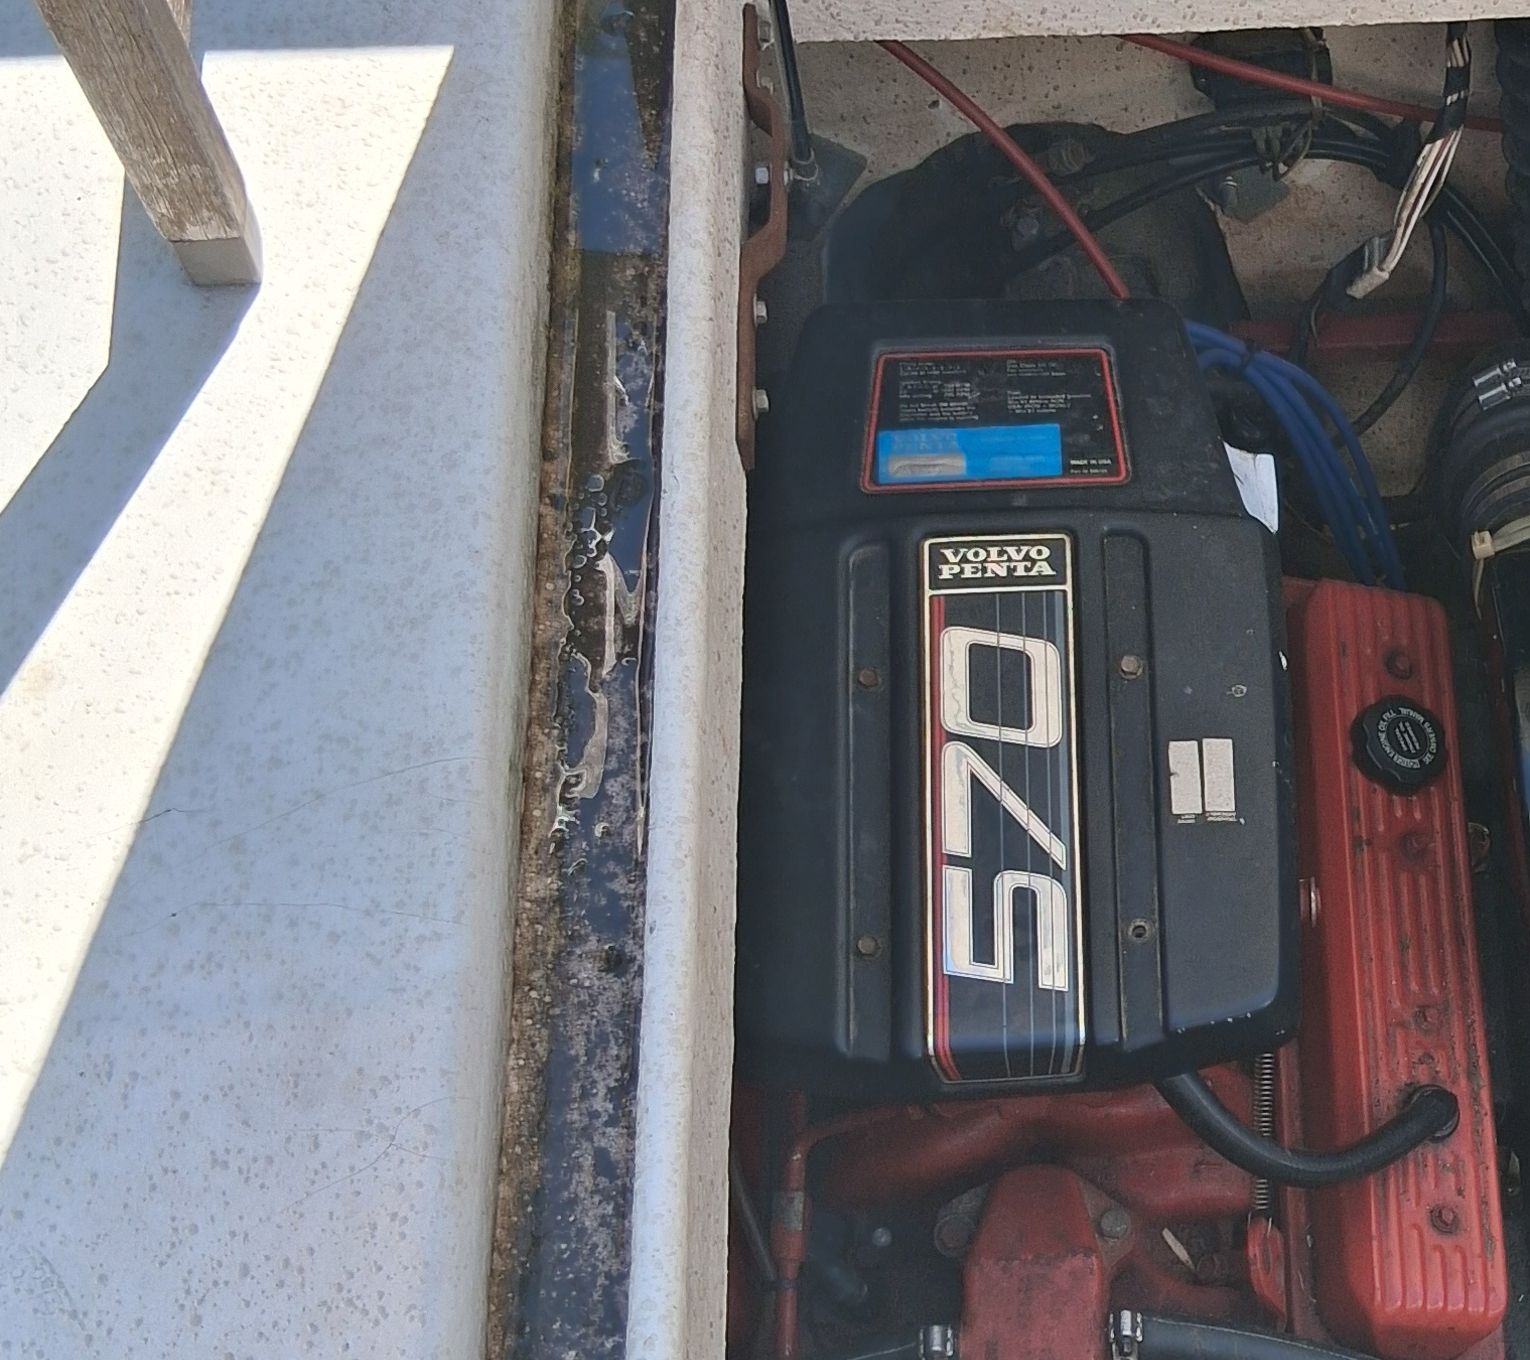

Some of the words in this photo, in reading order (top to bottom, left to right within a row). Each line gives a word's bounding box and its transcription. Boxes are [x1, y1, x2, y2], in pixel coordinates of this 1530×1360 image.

[940, 544, 1051, 562] VOLVO
[938, 559, 1057, 579] PENTA
[941, 625, 1069, 992] 570
